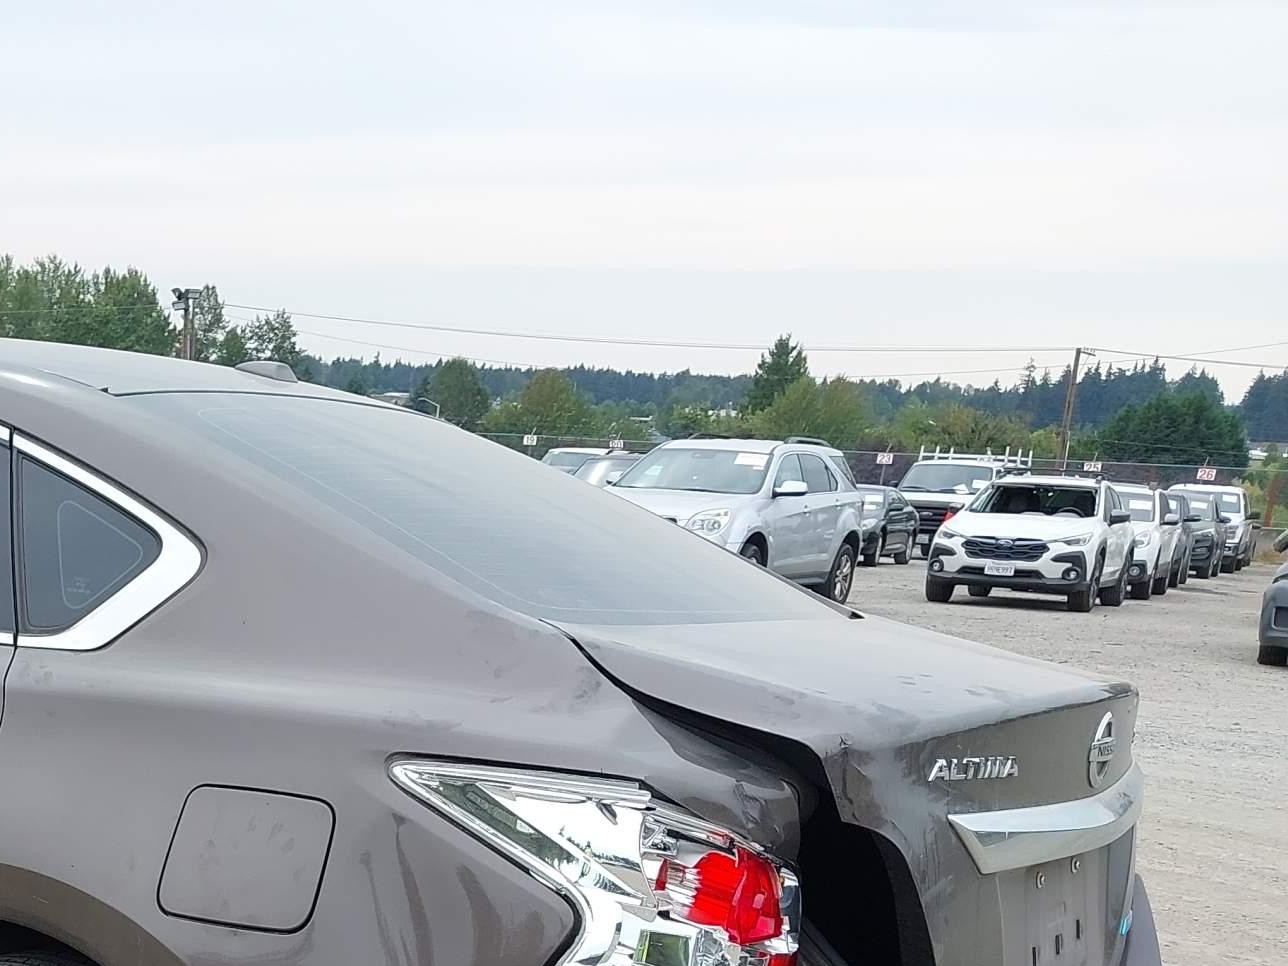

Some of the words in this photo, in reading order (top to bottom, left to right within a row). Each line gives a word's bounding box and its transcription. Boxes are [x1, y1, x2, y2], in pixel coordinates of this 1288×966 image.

[878, 454, 891, 463] 23
[1086, 463, 1100, 471] 25
[1199, 470, 1213, 480] 26
[928, 756, 1019, 781] ALTIMA
